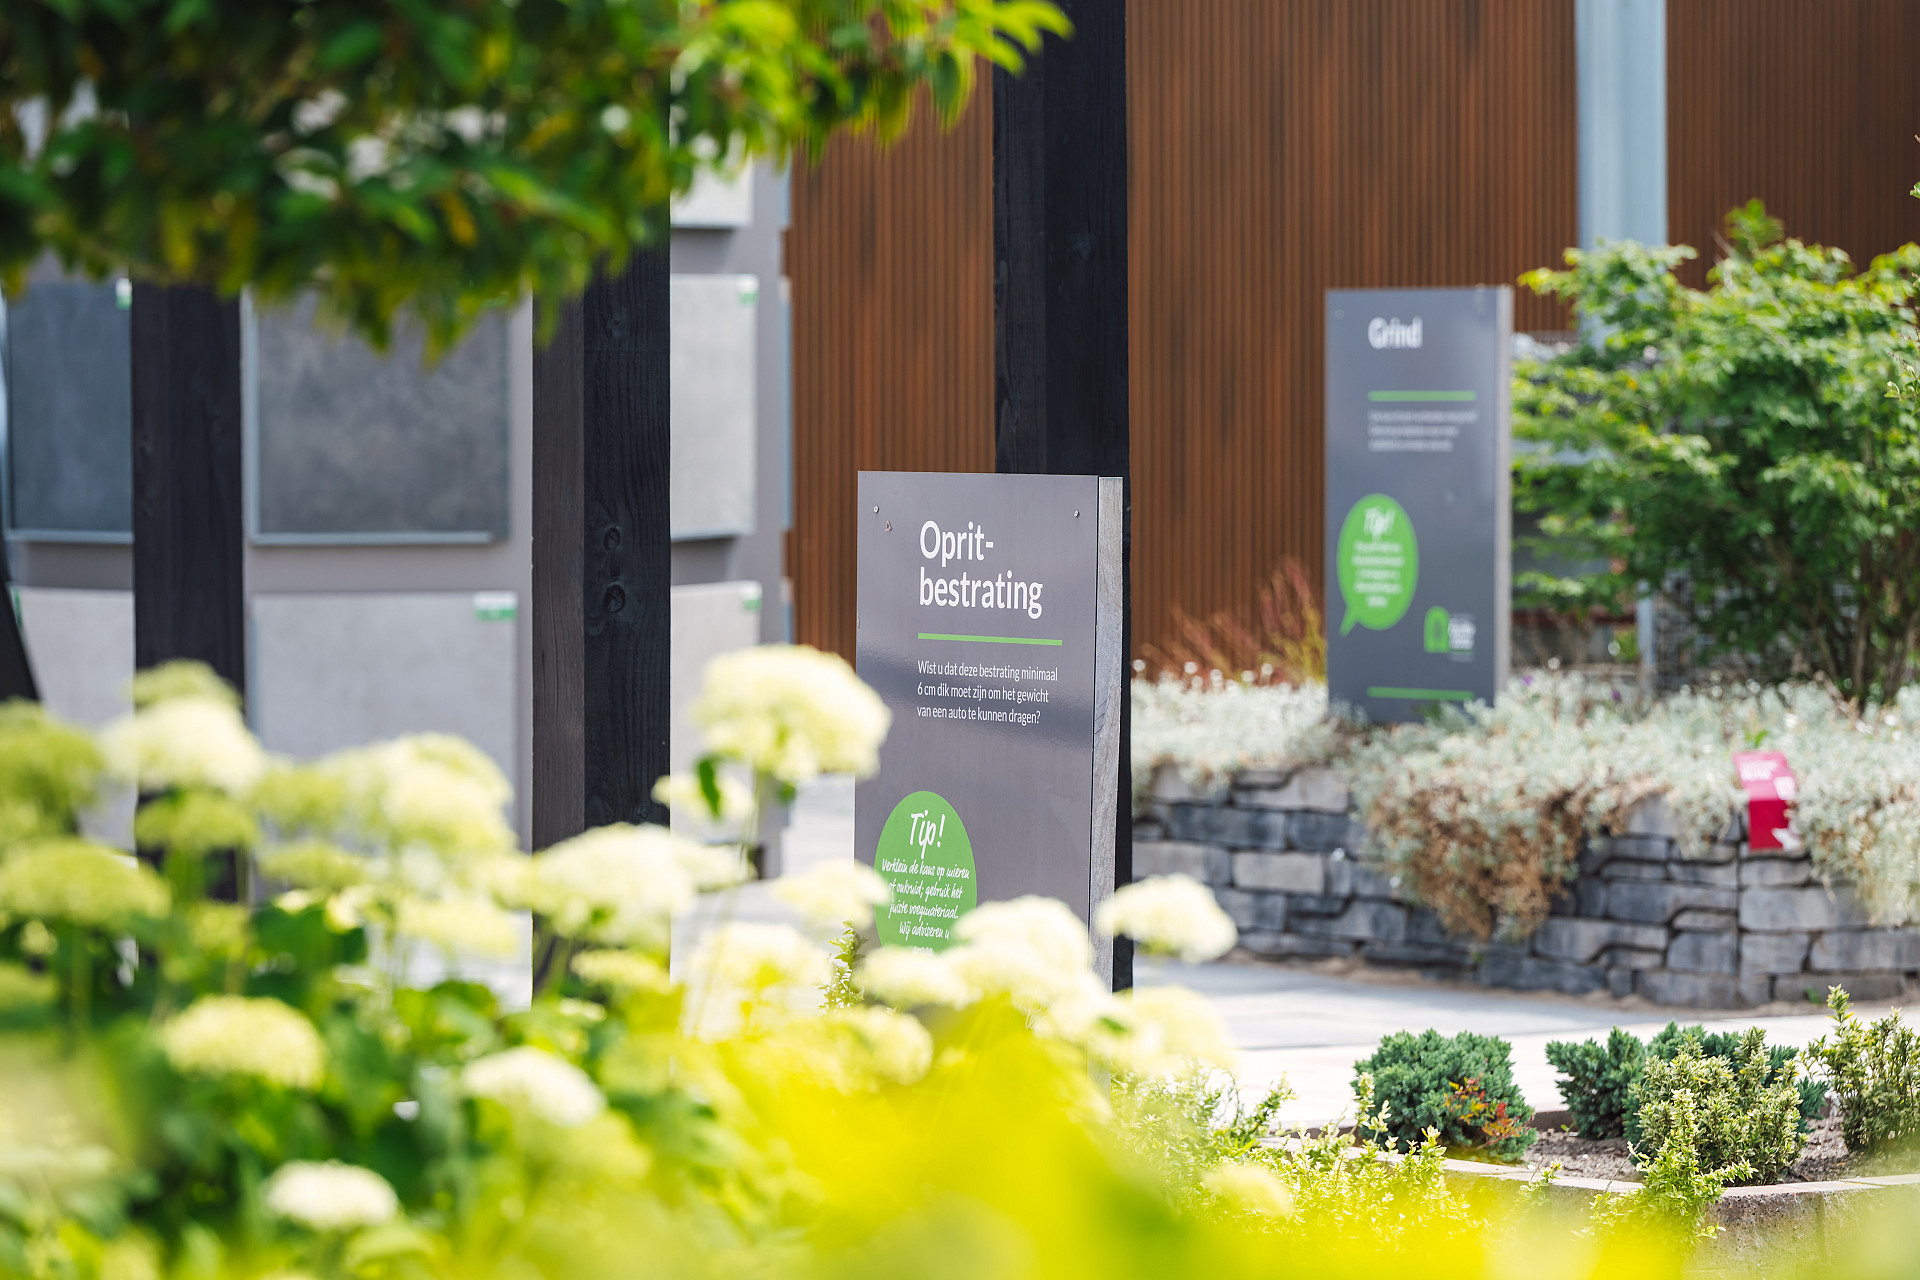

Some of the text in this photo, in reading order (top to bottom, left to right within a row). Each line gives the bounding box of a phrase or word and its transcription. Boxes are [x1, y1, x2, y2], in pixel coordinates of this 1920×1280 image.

[1368, 316, 1423, 349] Grind
[919, 520, 994, 568] Oprit-
[919, 566, 1044, 620] bestrating
[917, 660, 1058, 682] Wist u dat deze bestrating minimaal
[917, 681, 1049, 704] 6 cm dik moet zijn om het gewicht
[916, 706, 1041, 727] van een auto te kunnen dragen?
[909, 809, 946, 860] Tip!
[881, 858, 970, 882] Verklein de kans op wieren
[888, 878, 897, 895] of
[924, 881, 951, 903] gebruik
[951, 882, 964, 899] het
[888, 899, 909, 919] juiste
[899, 920, 950, 942] Wij adviseren u
